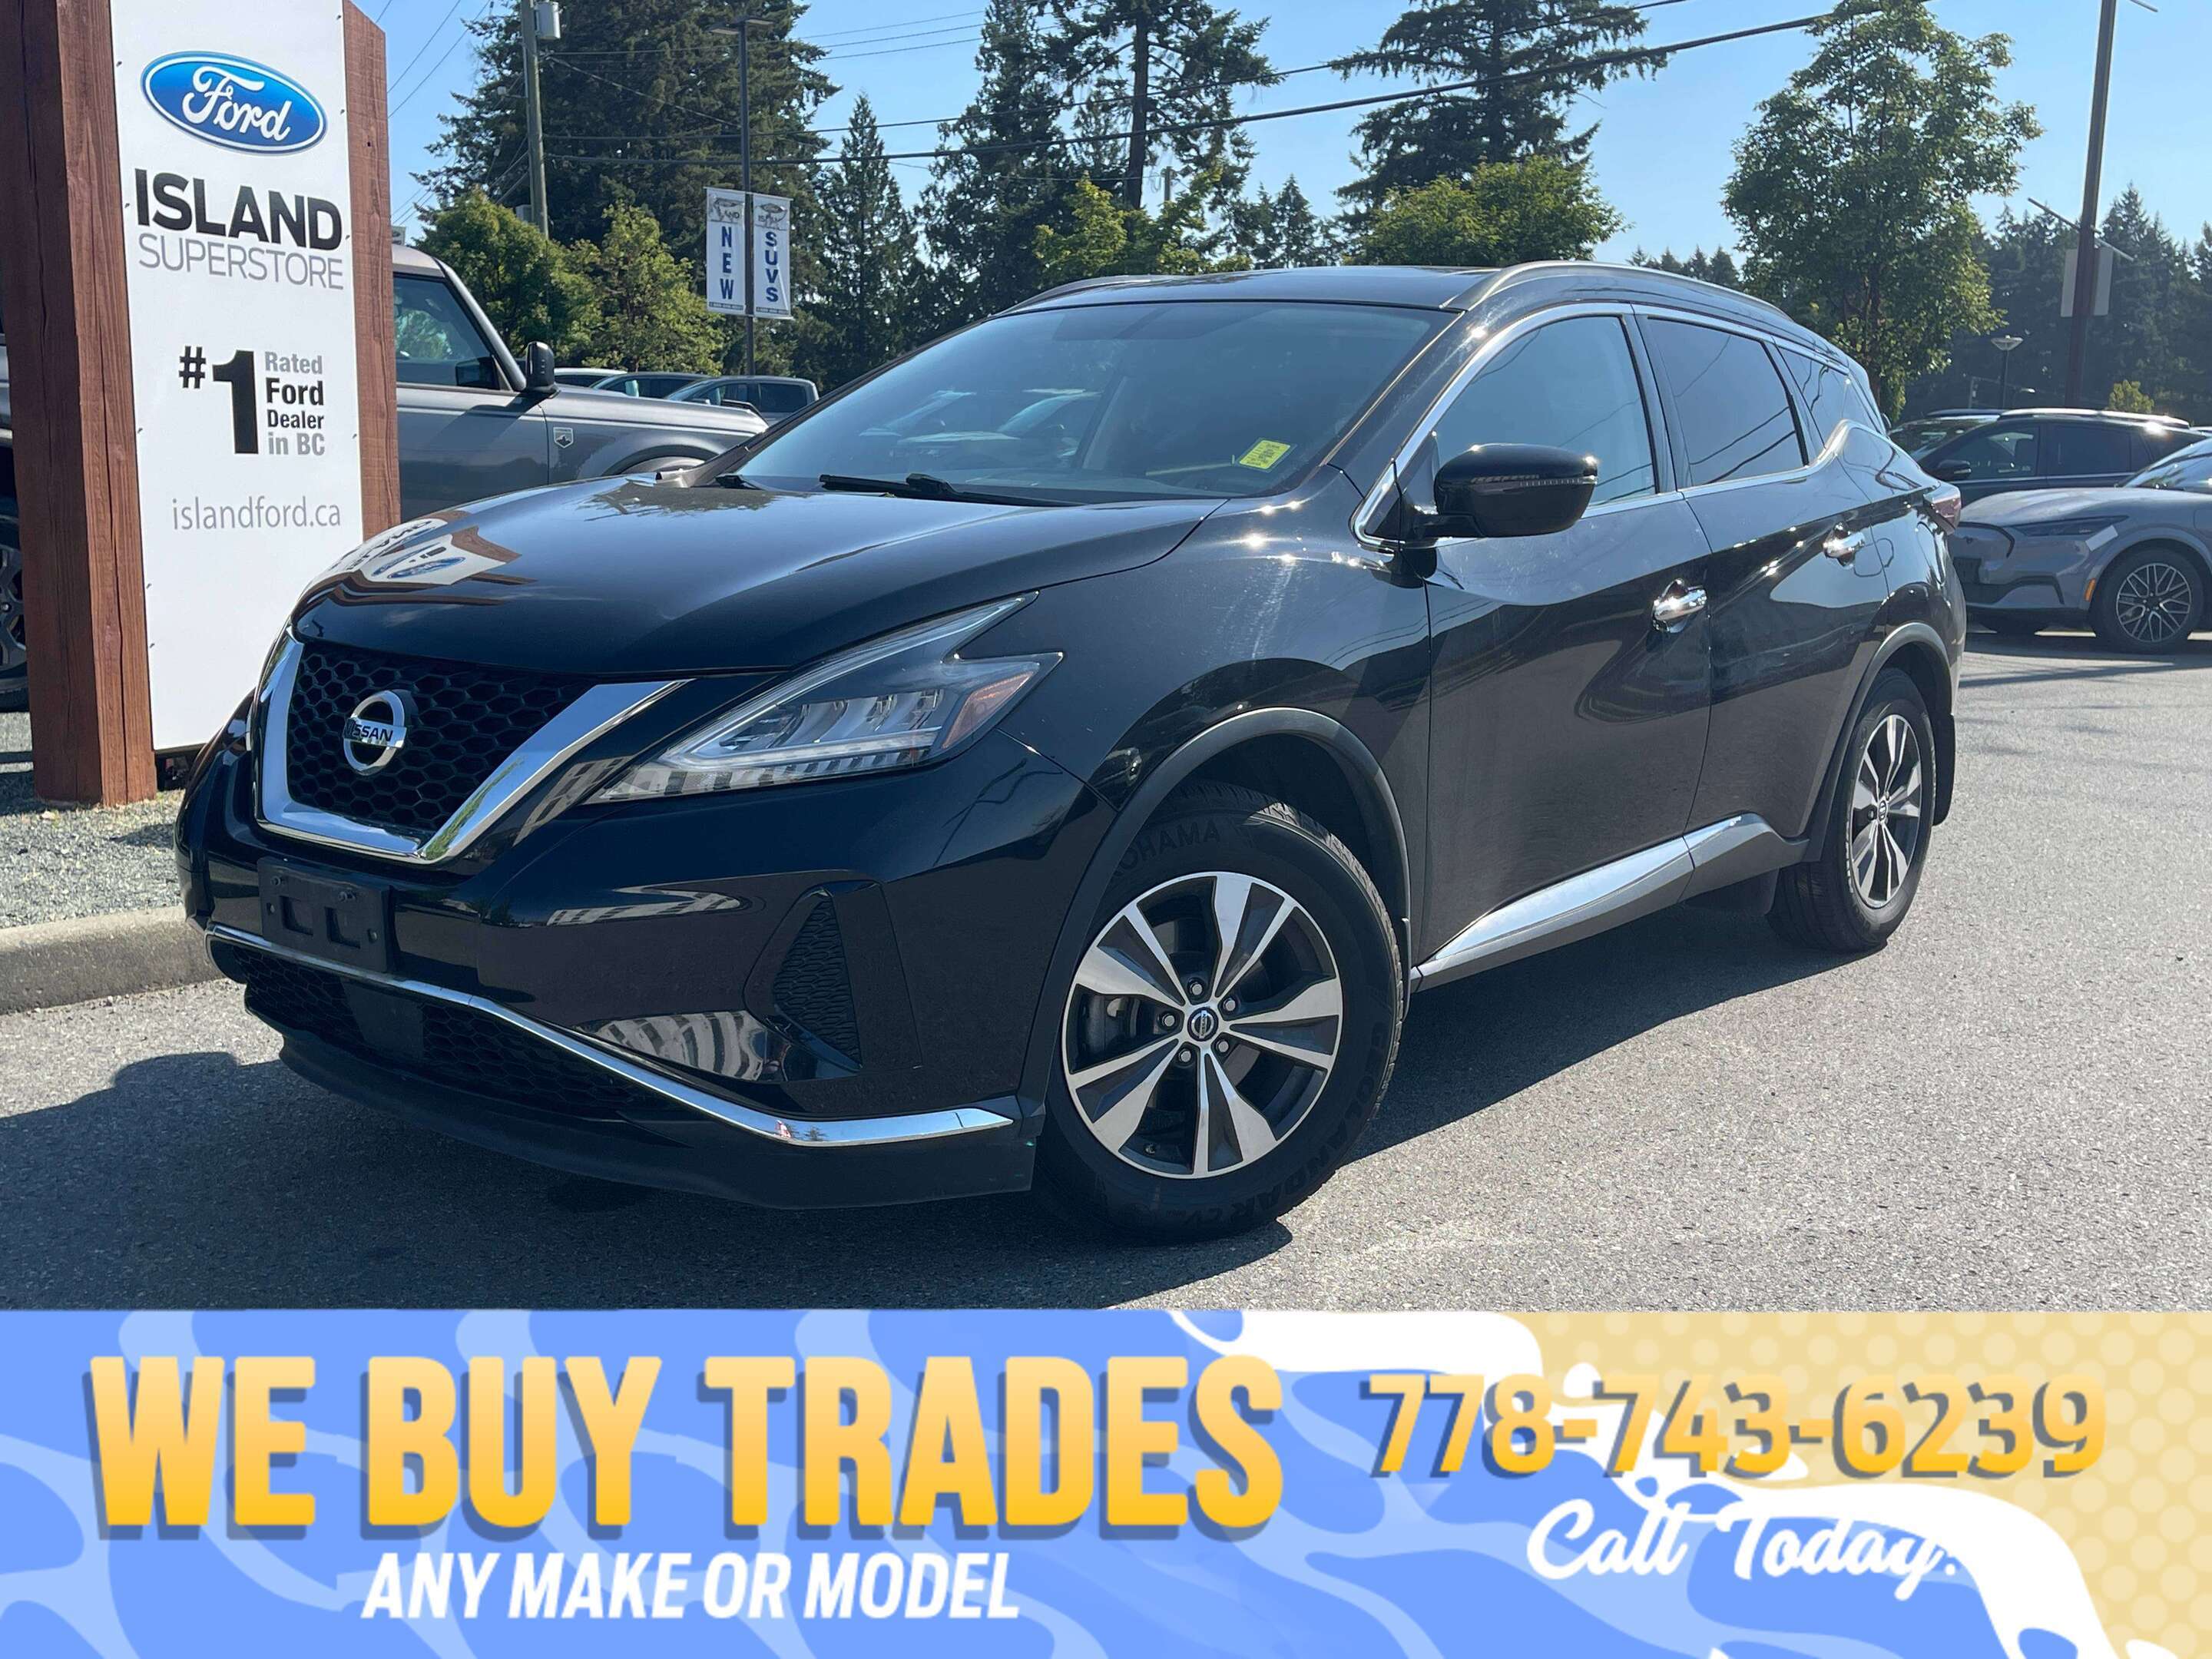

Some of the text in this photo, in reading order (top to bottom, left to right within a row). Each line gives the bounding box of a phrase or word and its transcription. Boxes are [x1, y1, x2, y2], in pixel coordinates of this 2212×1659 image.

[183, 66, 291, 141] Ford
[135, 168, 343, 251] ISLAND
[139, 233, 344, 290] SUPERSTORE
[720, 226, 735, 300] NEW
[764, 231, 779, 303] SUVS
[264, 351, 323, 375] Rated
[179, 346, 260, 455] #1
[266, 376, 324, 406] Ford
[267, 409, 325, 429] Dealer
[269, 432, 326, 456] in BC
[173, 495, 341, 530] islandford.ca
[344, 720, 394, 742] NISSAN
